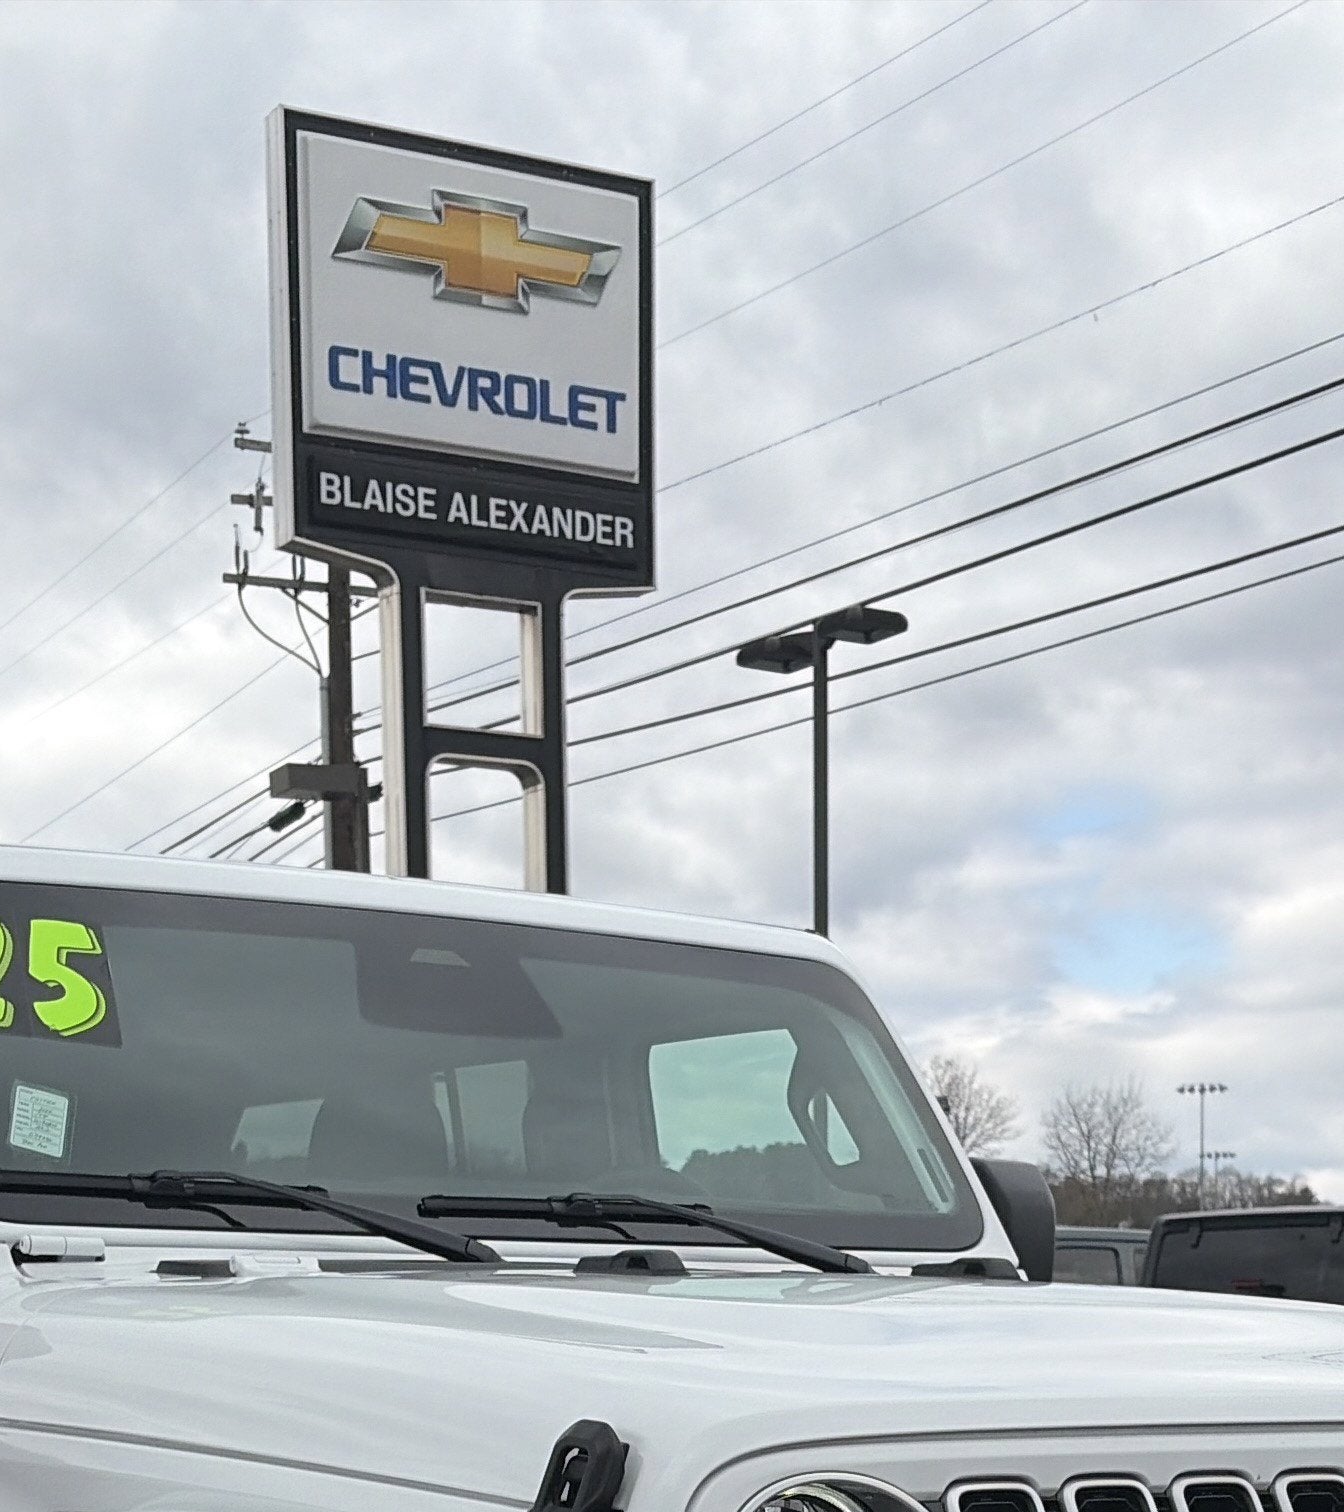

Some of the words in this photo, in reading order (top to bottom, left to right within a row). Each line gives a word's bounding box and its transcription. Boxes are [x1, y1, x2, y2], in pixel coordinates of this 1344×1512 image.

[327, 344, 627, 435] CHEVROLET
[319, 471, 438, 521] BLAISE
[447, 492, 635, 549] ALEXANDER
